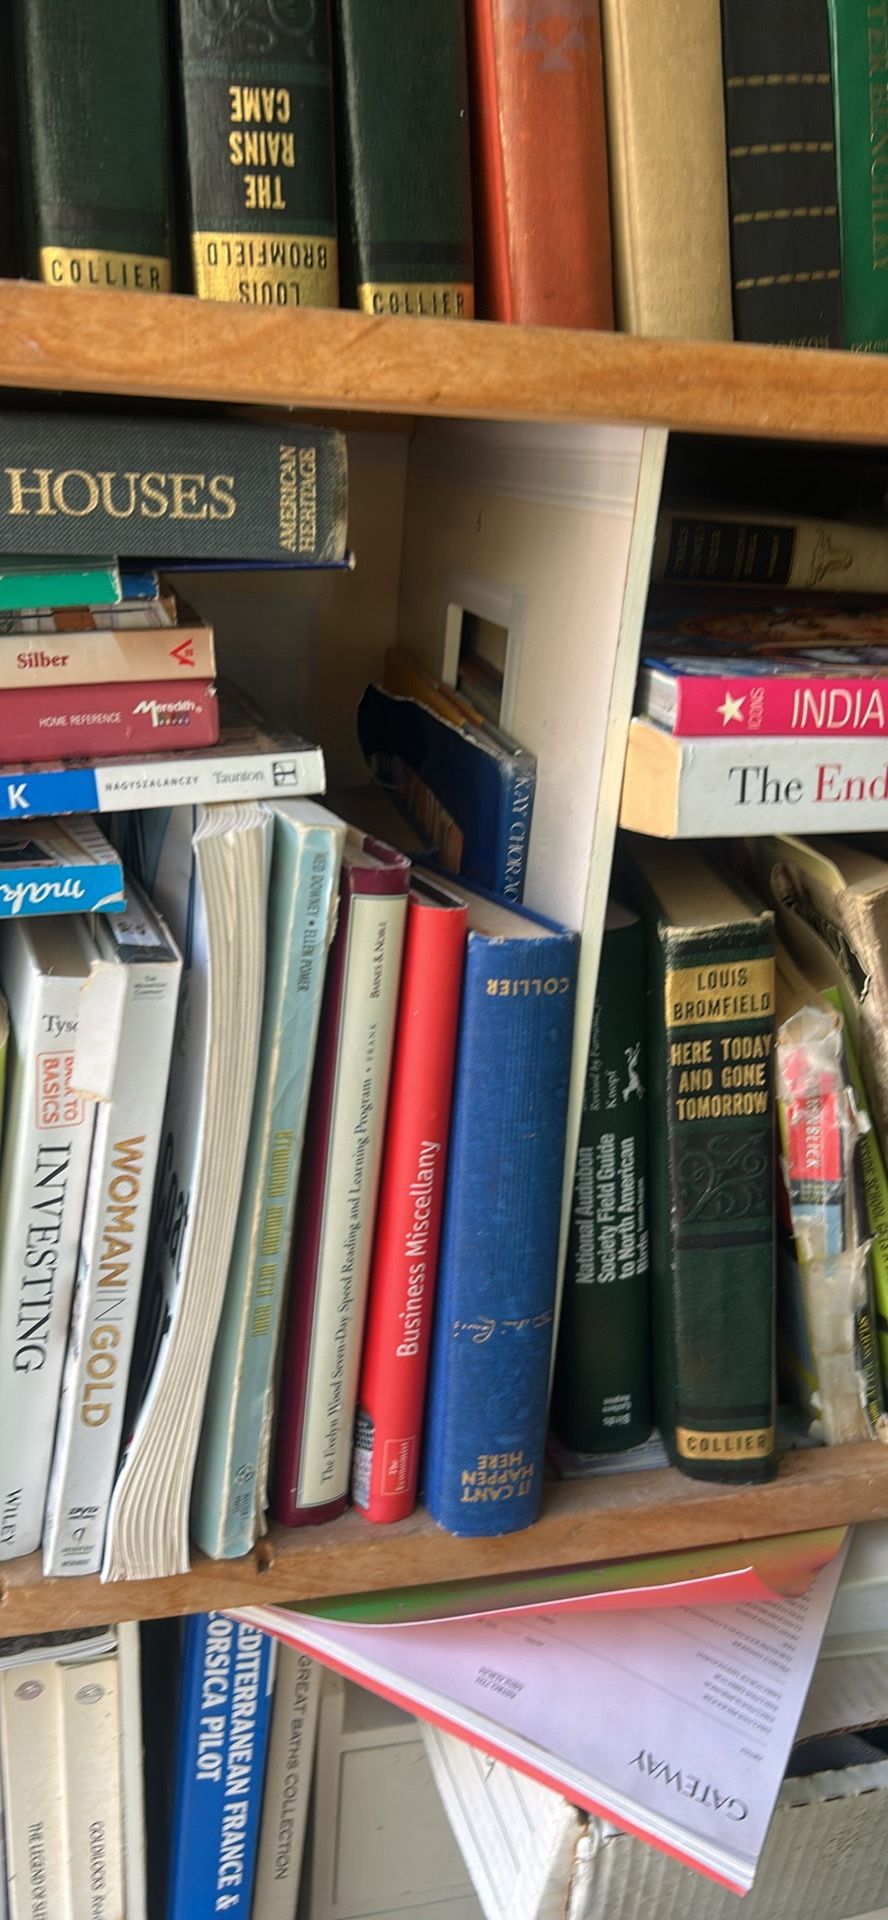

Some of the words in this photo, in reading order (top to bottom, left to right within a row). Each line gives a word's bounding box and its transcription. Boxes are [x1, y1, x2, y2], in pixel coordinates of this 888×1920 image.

[229, 85, 291, 123] CAME
[229, 131, 295, 167] RAINS
[245, 175, 286, 209] THE
[51, 258, 161, 287] COLLIER
[207, 241, 328, 270] BROMFIELD
[239, 281, 300, 306] LOUIS
[372, 291, 465, 315] COLLIER
[5, 468, 237, 520] HOUSES
[279, 445, 296, 552] AMERICAN
[299, 447, 316, 552] HERITAGE
[16, 651, 69, 669] Silber
[39, 716, 68, 729] HOME
[70, 711, 122, 726] REFERENCE
[790, 688, 885, 728] INDIA
[8, 783, 30, 809] K
[212, 769, 264, 784] Taunton
[511, 776, 532, 813] KAY
[728, 763, 804, 806] The
[814, 763, 888, 803] End
[486, 977, 570, 997] COLLIER
[696, 968, 748, 991] LOUIS
[673, 993, 771, 1022] BROMFIELD
[670, 1038, 713, 1067] HERE
[720, 1033, 774, 1061] TODAY
[42, 1057, 60, 1126] BASICS
[605, 1069, 619, 1109] Knopf
[678, 1067, 713, 1094] AND
[720, 1062, 767, 1089] GONE
[65, 1100, 78, 1122] TO
[353, 1079, 374, 1135] Program
[675, 1090, 769, 1122] TOMORROW
[348, 1136, 369, 1194] Learning
[596, 1132, 617, 1180] Guide
[618, 1136, 636, 1212] American
[405, 1140, 441, 1257] Miscellany
[575, 1147, 596, 1217] Audubon
[596, 1182, 617, 1221] Field
[347, 1197, 361, 1221] and
[339, 1222, 361, 1274] Reading
[575, 1220, 595, 1285] National
[596, 1225, 618, 1283] Society
[618, 1216, 635, 1258] North
[13, 1141, 72, 1374] INVESTING
[618, 1262, 634, 1280] to
[336, 1276, 354, 1313] Speed
[396, 1262, 426, 1358] Business
[333, 1316, 348, 1380] Seven-Day
[326, 1382, 342, 1417] Wood
[323, 1418, 339, 1460] Evelyn
[686, 1433, 767, 1452] COLLIER
[320, 1460, 335, 1485] The
[461, 1463, 536, 1487] HAPPEN
[477, 1451, 524, 1471] HERE
[0, 1486, 23, 1546] WILEY
[293, 1654, 313, 1712] GREAT
[196, 1714, 226, 1782] PILOT
[286, 1719, 302, 1770] BATHS
[628, 1748, 750, 1823] GATEWAY
[28, 1820, 44, 1842] THE
[216, 1800, 249, 1890] FRANCE
[274, 1773, 299, 1880] COLLECTION
[29, 1843, 46, 1886] LEGEND
[88, 1820, 107, 1891] GOLDILOCKS
[31, 1886, 46, 1900] OF
[215, 1893, 241, 1912] &
